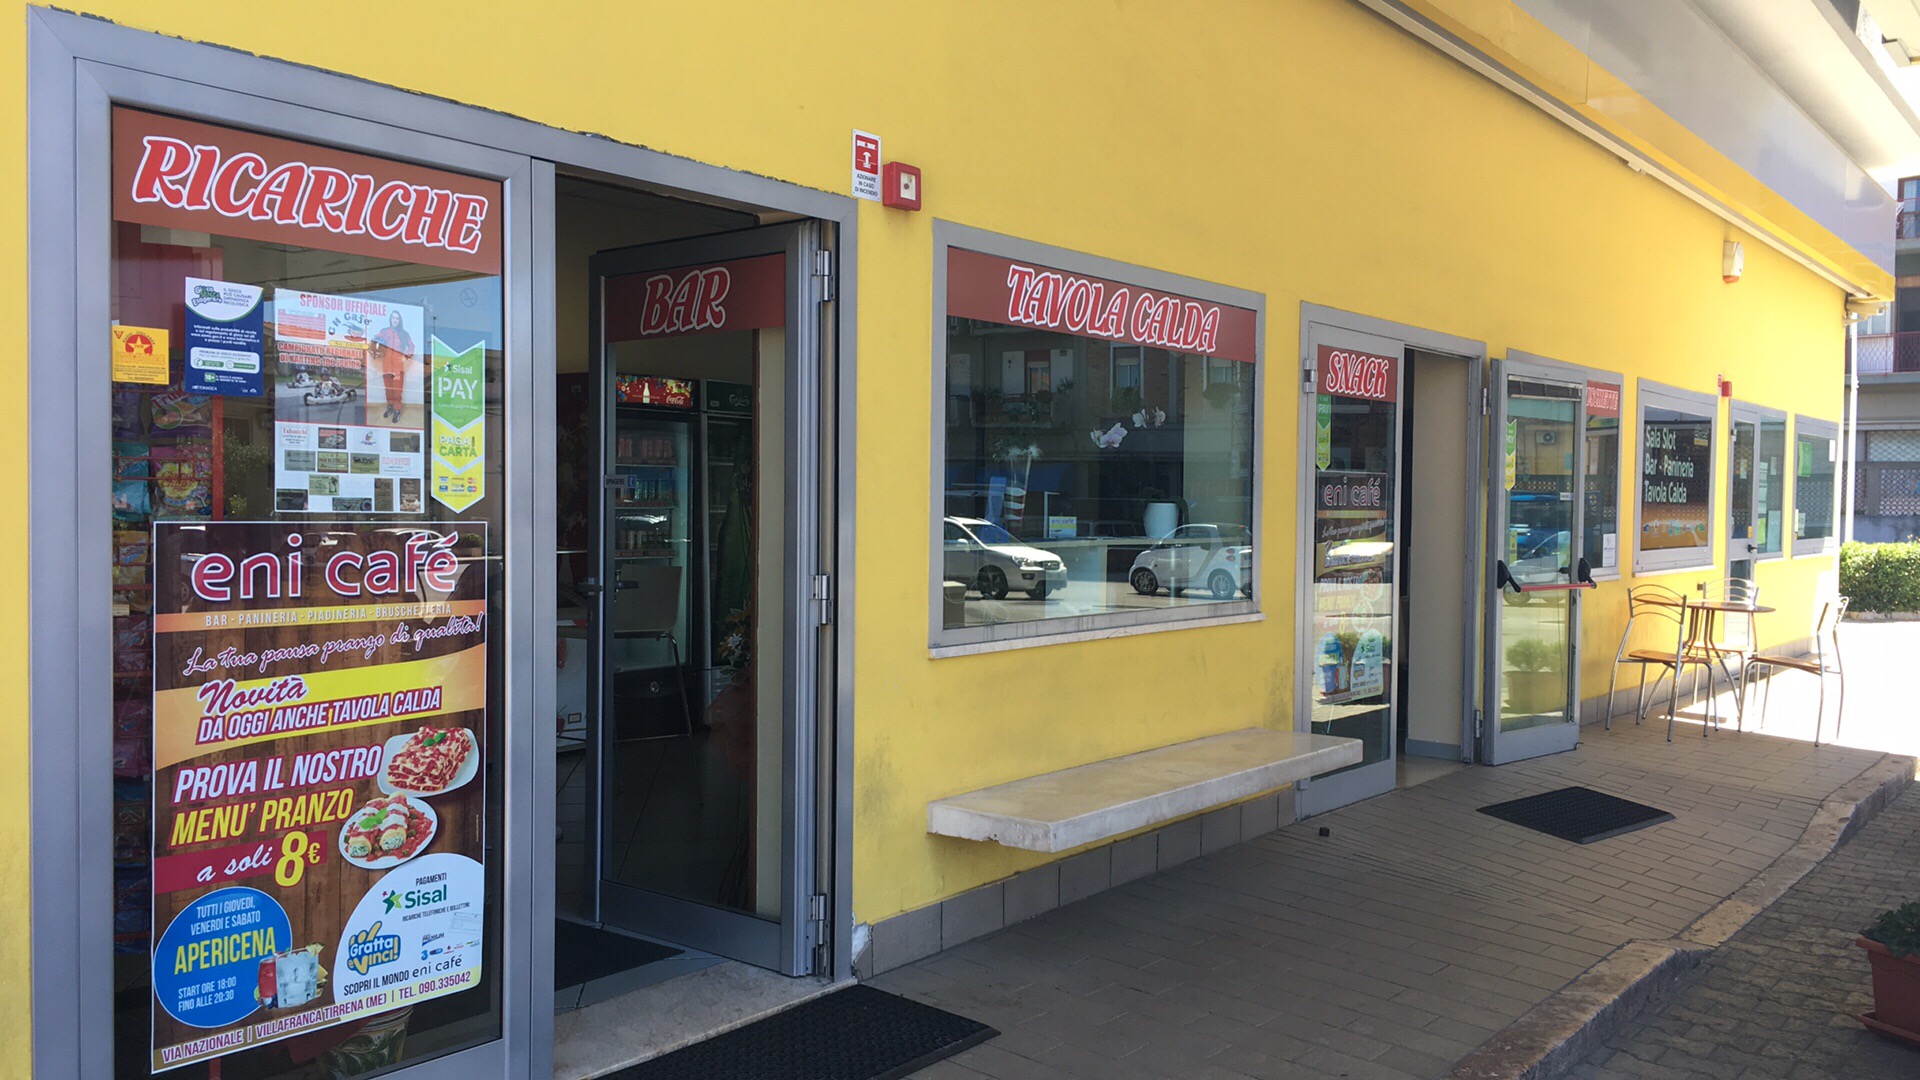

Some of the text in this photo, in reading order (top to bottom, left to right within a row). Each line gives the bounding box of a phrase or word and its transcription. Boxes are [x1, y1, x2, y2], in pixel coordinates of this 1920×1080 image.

[132, 136, 488, 254] RICARICHE
[300, 294, 386, 316] SPONSOR UFFICIALE
[640, 267, 730, 335] BAR
[1007, 264, 1219, 353] TAVOLA CALDA
[278, 342, 326, 354] CAMPIONATO
[326, 348, 363, 359] REGIONALE
[289, 354, 320, 366] KARTING
[452, 364, 472, 374] Sisal
[1326, 351, 1389, 398] SNACK
[438, 377, 478, 400] PAY
[439, 435, 470, 446] PAGA
[1646, 426, 1660, 448] Sala
[1662, 428, 1676, 450] Slot
[439, 446, 478, 458] CARTA
[1646, 453, 1658, 475] Bar
[1664, 455, 1694, 478] Panineria
[1324, 477, 1380, 507] eni café
[1644, 480, 1686, 503] Tavola Calda
[191, 531, 459, 601] eni café
[206, 614, 228, 628] BAR
[239, 611, 298, 625] PANINERIA
[308, 608, 366, 622] PIADINERIA
[376, 604, 452, 618] BRUSCHETTERIA
[183, 612, 484, 677] La tua pausa pranzo di qualità!
[197, 675, 309, 716] Novità
[196, 686, 442, 744] DA OGGI ANCHE TAVOLA CALDA
[173, 744, 384, 804] PROVA IL NOSTRO
[259, 788, 355, 832] PRANZO
[196, 864, 216, 884] a
[224, 842, 272, 875] soli
[416, 872, 448, 886] PAGAMENTI
[404, 884, 448, 909] Sisal
[190, 910, 261, 936] VENERDI E SABATO
[197, 904, 218, 919] TUTTI
[402, 912, 422, 922] RICARICHE
[422, 907, 446, 918] TELEFONICHE
[174, 926, 276, 975] APERICENA
[350, 937, 394, 958] Gratta
[412, 954, 462, 978] eni café
[178, 976, 236, 1000] START ORE 18:00
[344, 971, 410, 996] SCOPRI IL MONDO
[178, 989, 234, 1013] FINO ALLE 20:30
[162, 1046, 182, 1064] VIA
[184, 1030, 244, 1058] NAZIONALE
[256, 1010, 322, 1039] VILLAFRANCA
[324, 1000, 364, 1022] TIRRENA
[366, 992, 387, 1012] (ME)
[398, 986, 418, 1000] TEL.
[418, 971, 472, 996] 090.335042
